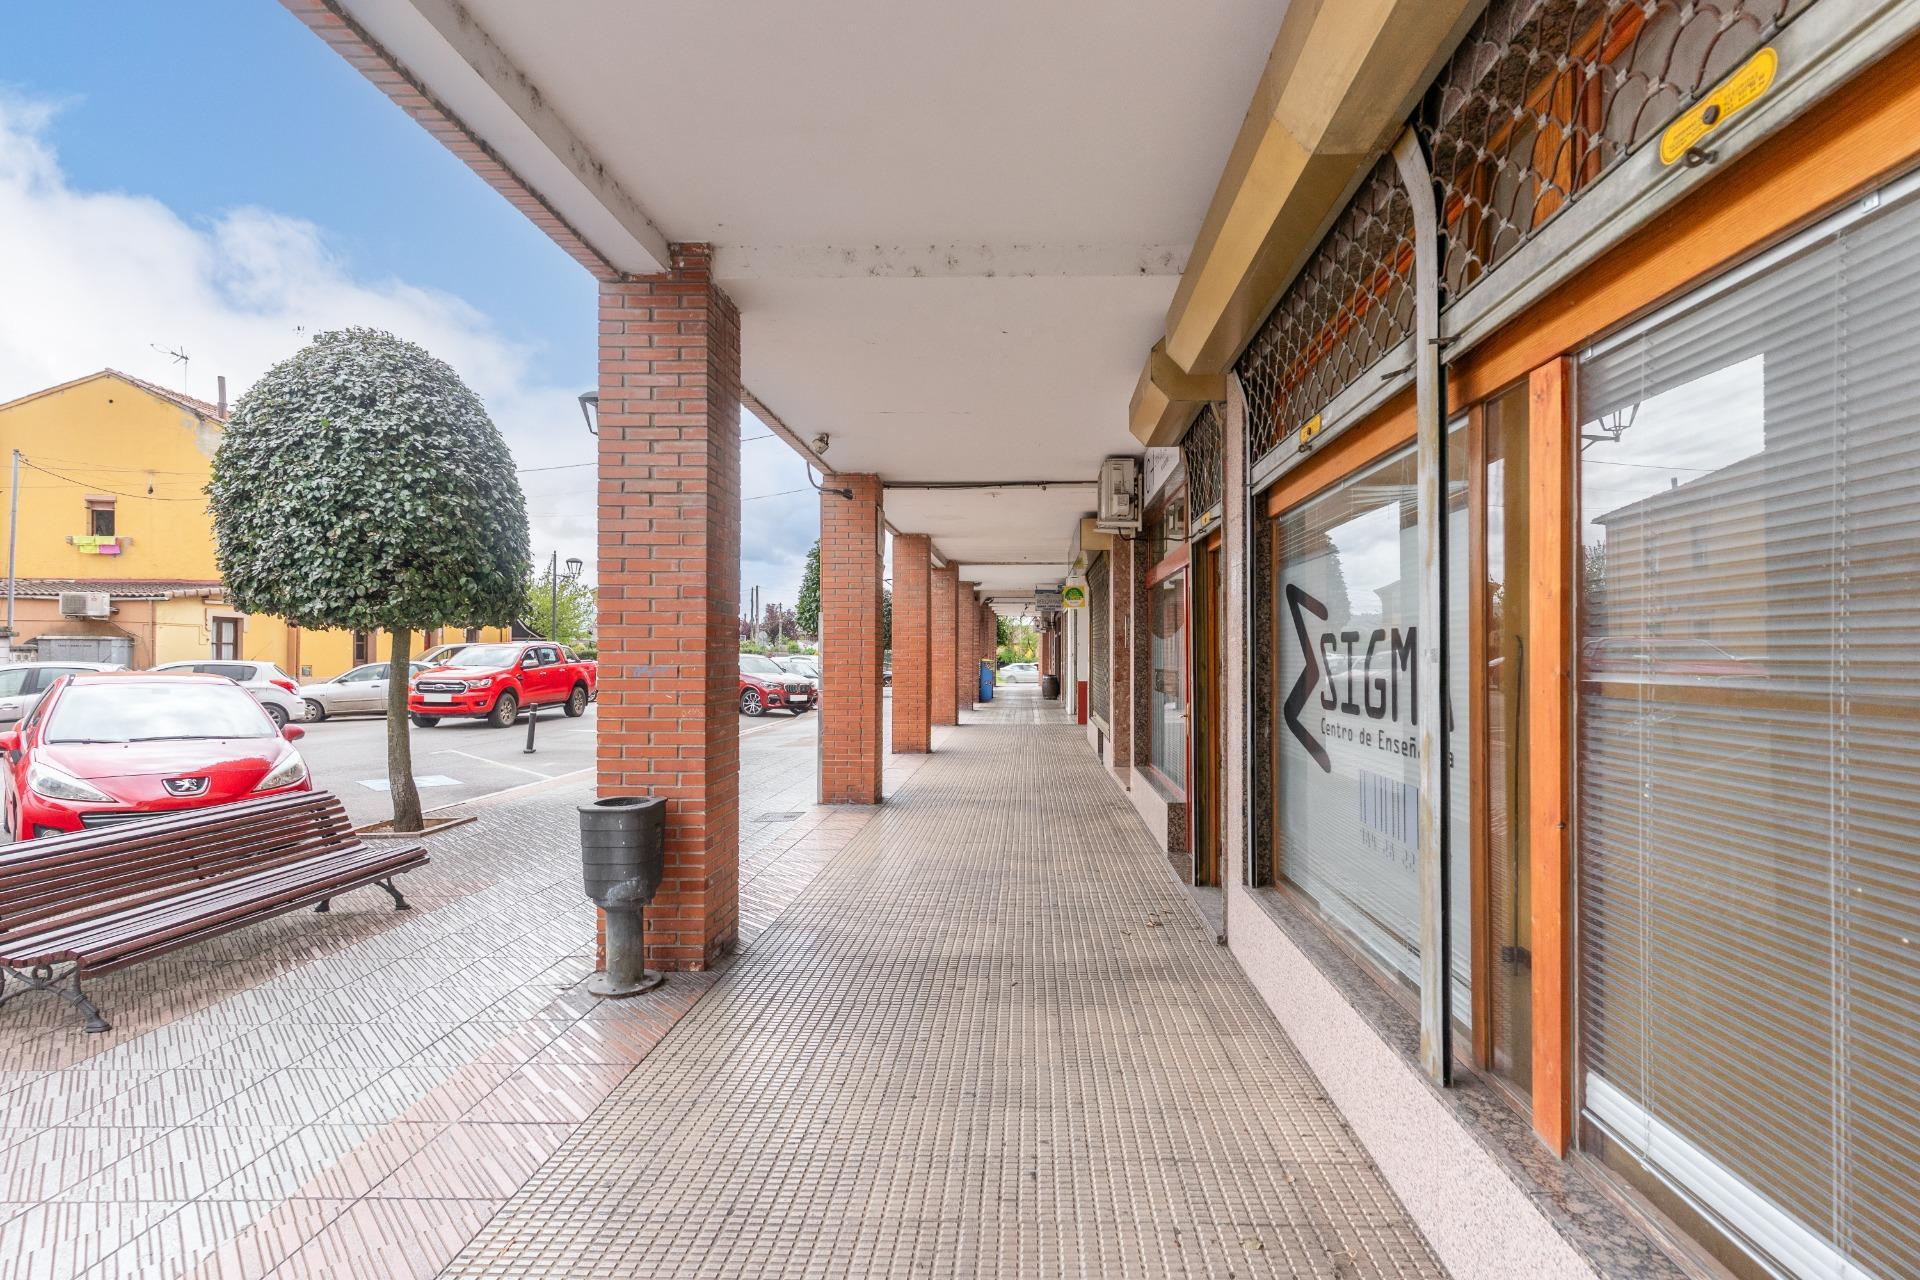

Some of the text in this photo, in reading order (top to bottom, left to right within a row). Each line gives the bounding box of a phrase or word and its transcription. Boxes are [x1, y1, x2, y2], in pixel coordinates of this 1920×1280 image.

[1320, 626, 1454, 732] SIGM
[1321, 717, 1353, 742] Centro
[1359, 727, 1372, 747] de
